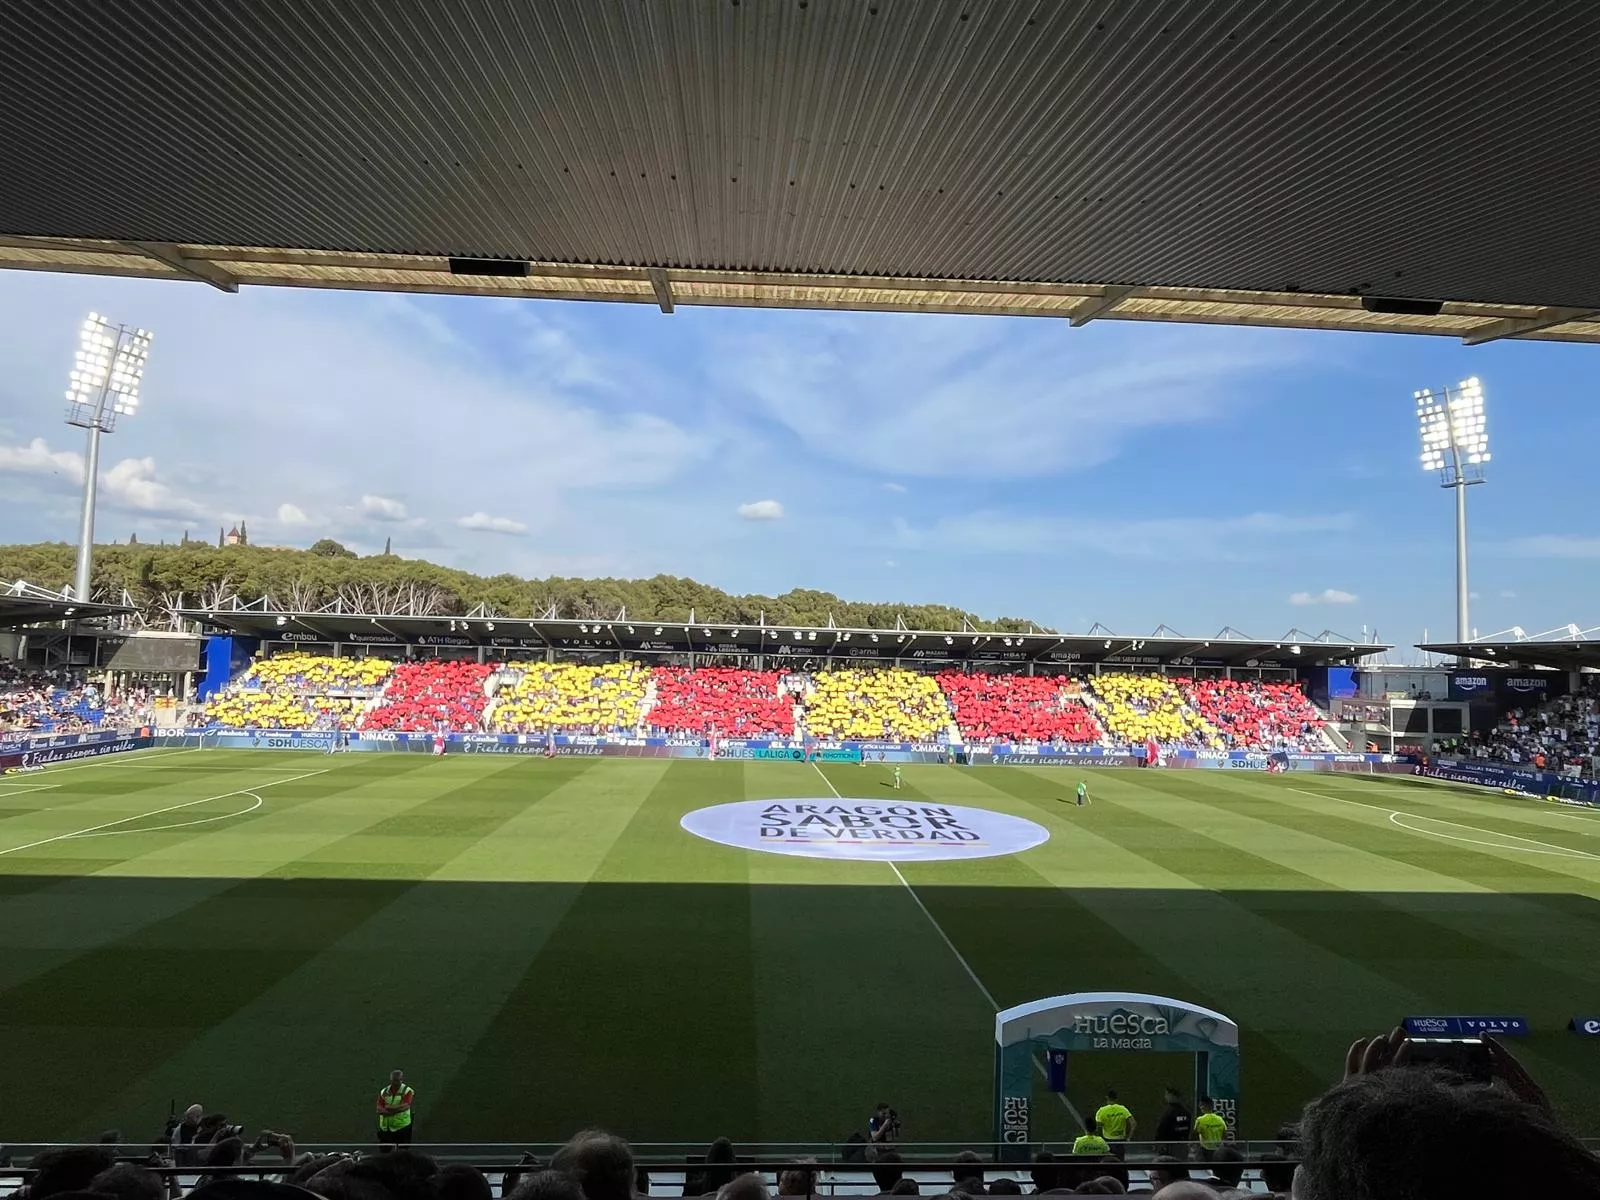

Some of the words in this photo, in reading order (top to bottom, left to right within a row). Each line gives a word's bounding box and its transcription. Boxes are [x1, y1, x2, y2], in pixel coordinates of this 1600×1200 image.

[1051, 652, 1081, 660] amazon
[1455, 676, 1487, 687] amazon
[1507, 678, 1547, 688] amazon
[759, 749, 790, 758] LALIGA
[760, 813, 971, 830] SABOR
[760, 827, 809, 838] DE
[823, 828, 982, 841] VERDAD
